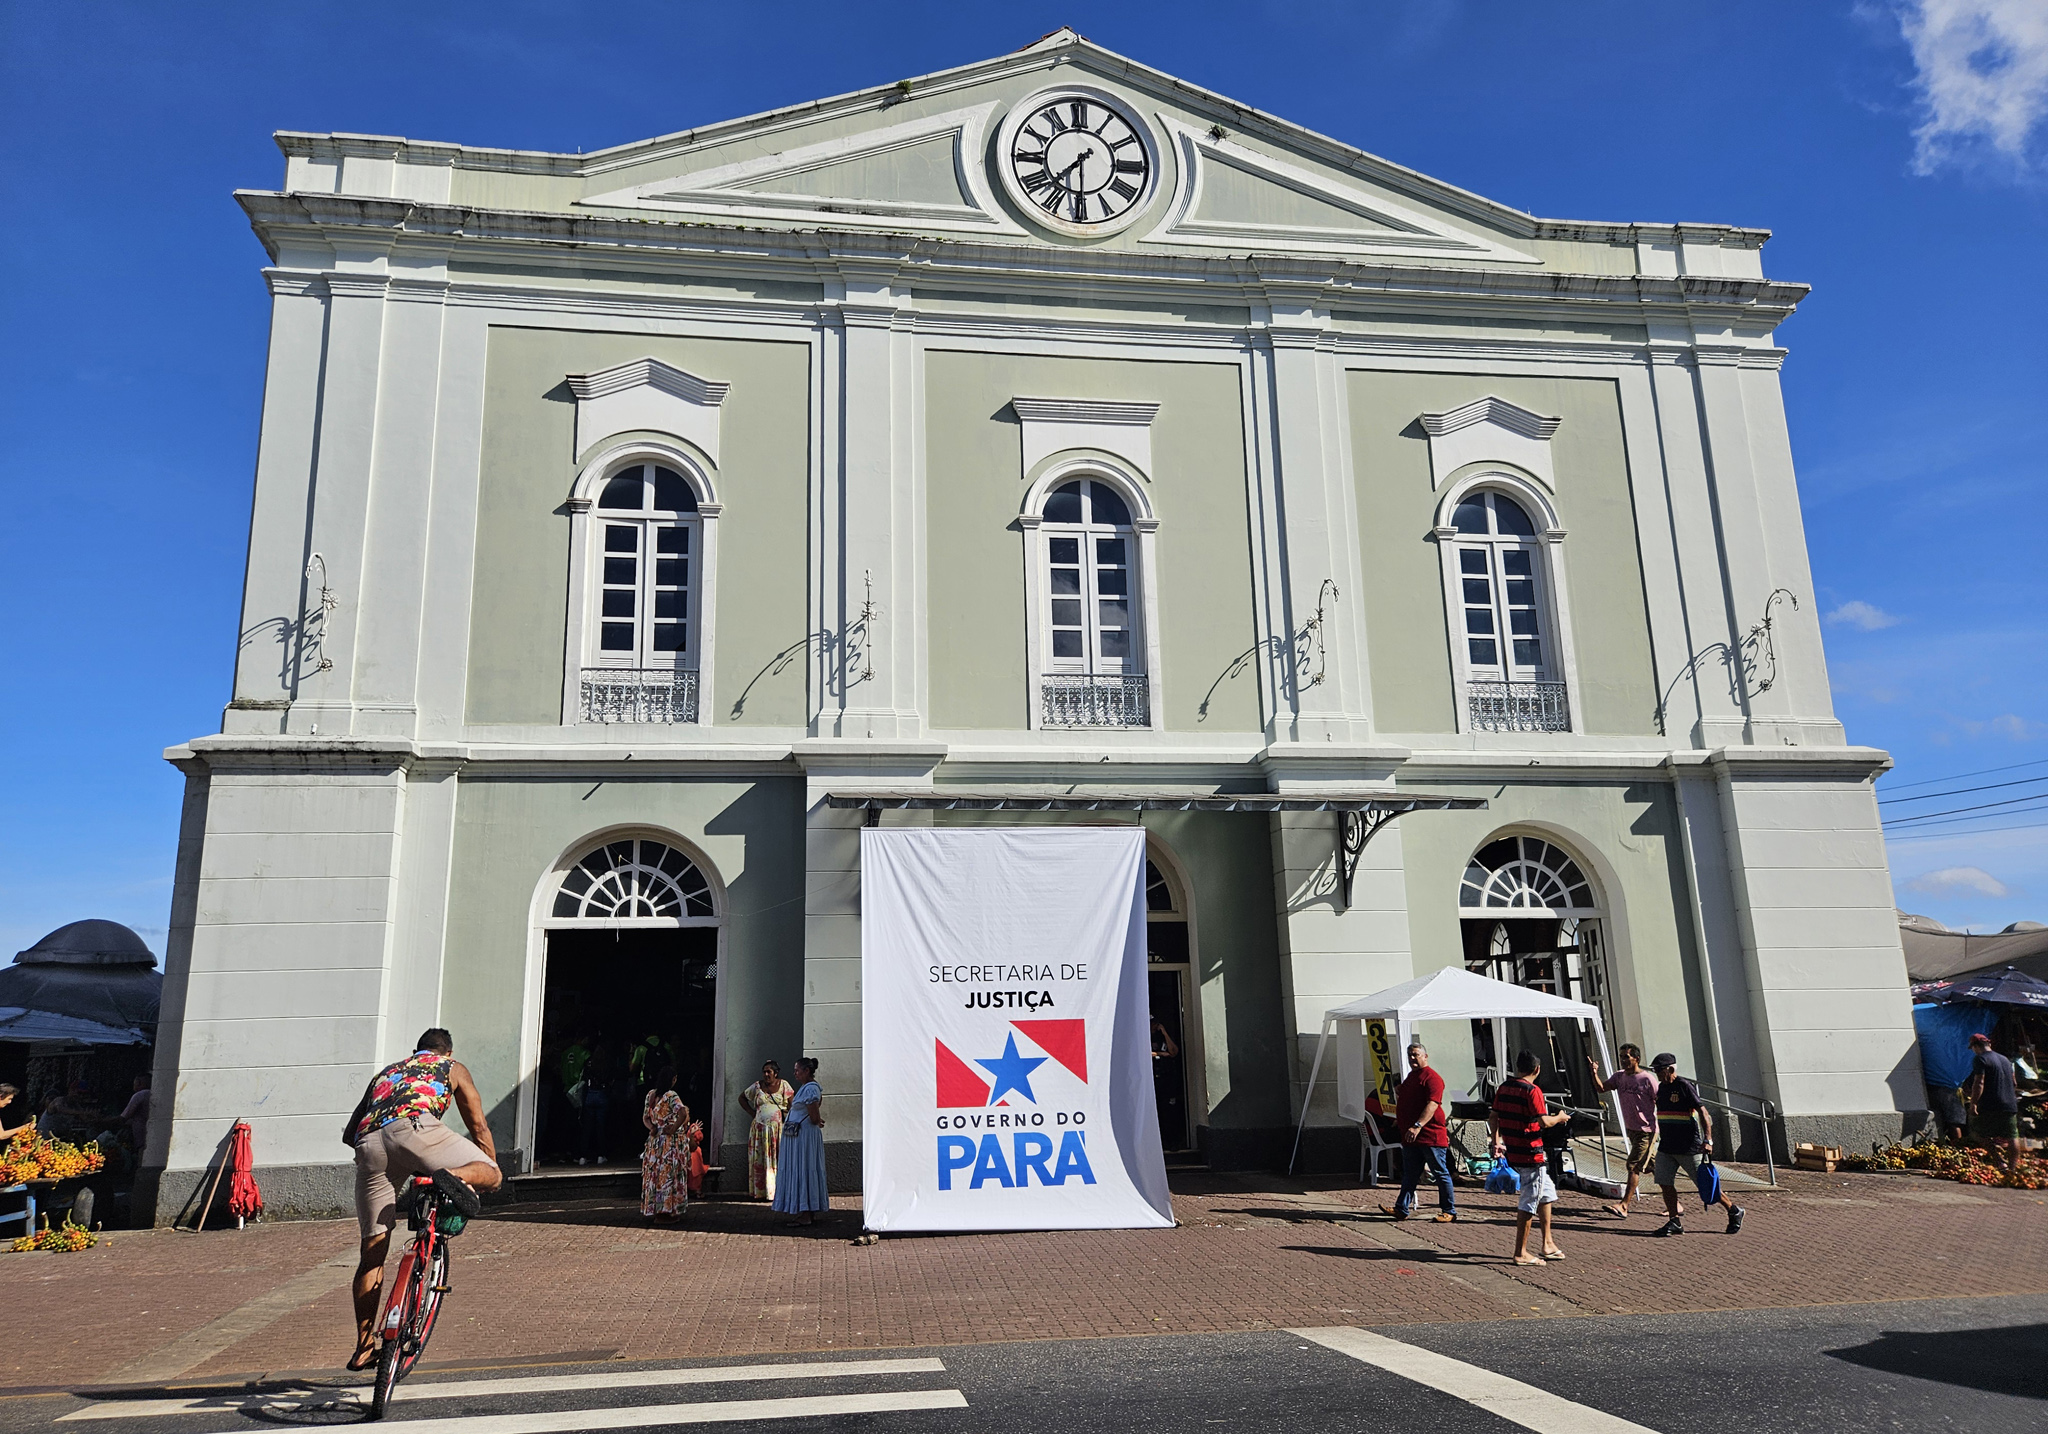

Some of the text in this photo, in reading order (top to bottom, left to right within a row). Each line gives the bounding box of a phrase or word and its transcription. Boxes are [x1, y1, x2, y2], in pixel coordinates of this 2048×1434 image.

[1042, 107, 1068, 132] XI
[1095, 113, 1114, 135] I
[1023, 124, 1050, 144] X
[1109, 134, 1136, 152] II
[1016, 148, 1044, 165] IX
[1020, 169, 1052, 194] VIII
[1041, 186, 1067, 214] VII
[1098, 193, 1115, 217] V
[929, 963, 1088, 983] SECRETARIA DE
[965, 990, 1055, 1013] JUSTIÇA
[936, 1111, 1086, 1130] GOVERNO DO
[937, 1130, 1097, 1191] PARÁ
